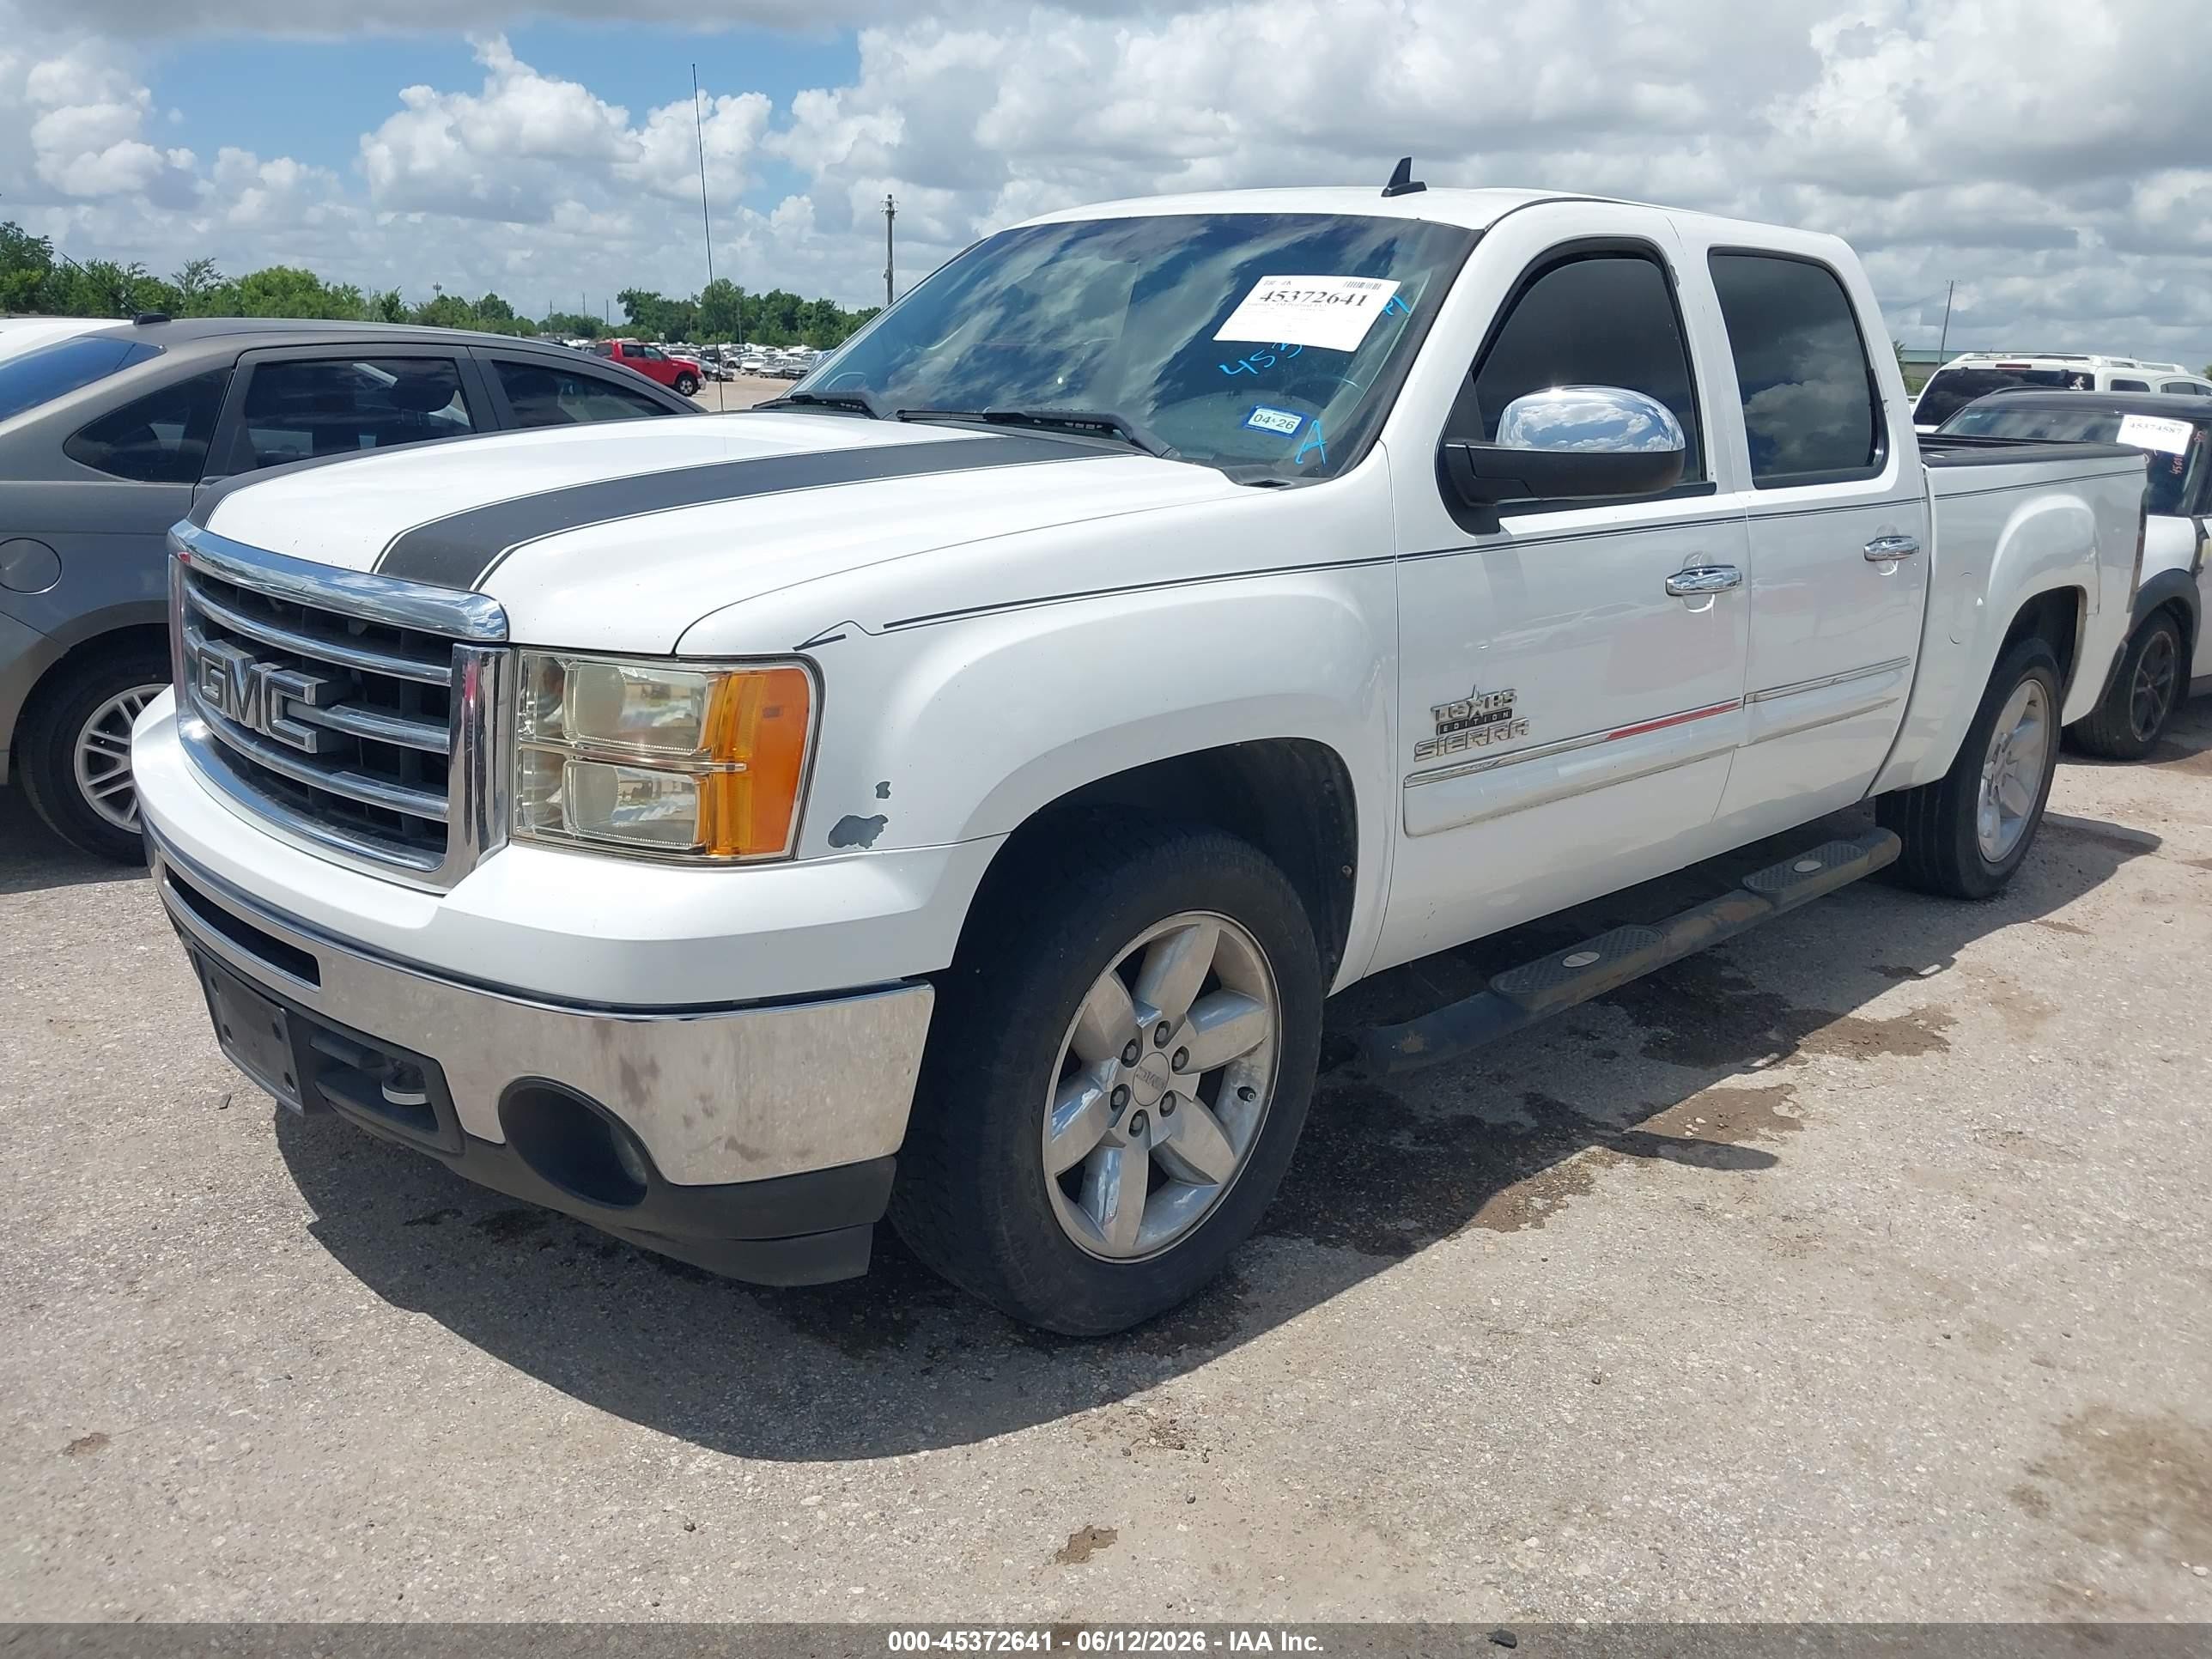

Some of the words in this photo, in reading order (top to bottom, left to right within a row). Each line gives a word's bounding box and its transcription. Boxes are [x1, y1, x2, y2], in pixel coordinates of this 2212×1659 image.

[1259, 290, 1368, 307] 45372641
[1295, 419, 1328, 465] A
[197, 641, 318, 754] GMC
[1413, 717, 1530, 762] SIERRA
[1443, 711, 1509, 732] EDITION
